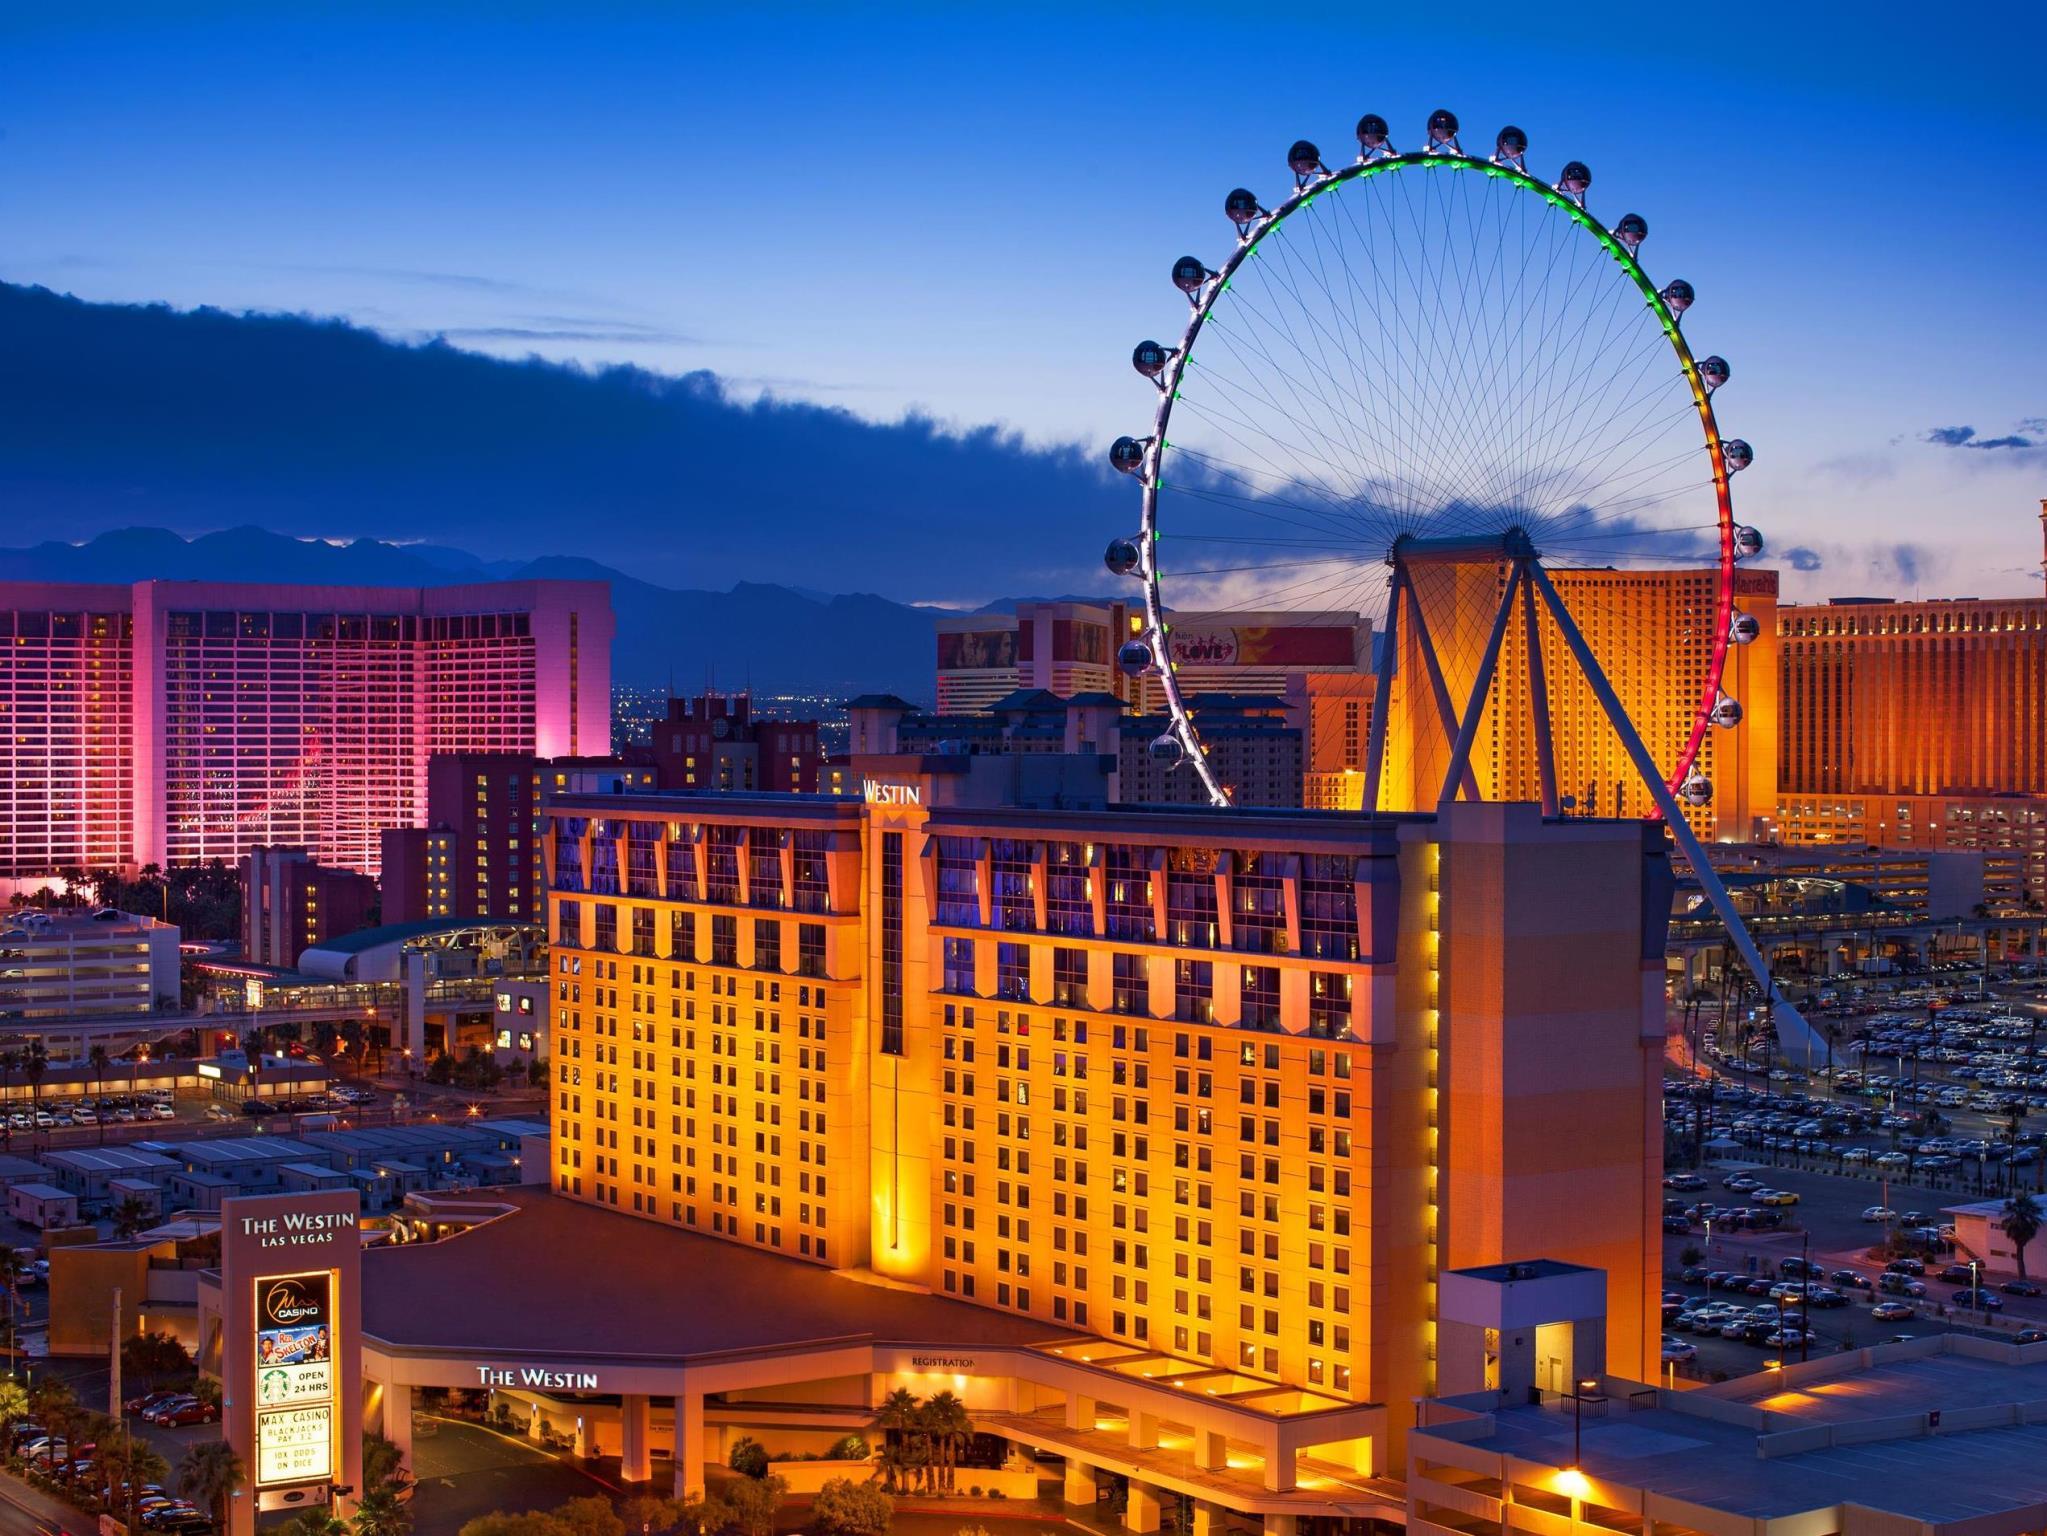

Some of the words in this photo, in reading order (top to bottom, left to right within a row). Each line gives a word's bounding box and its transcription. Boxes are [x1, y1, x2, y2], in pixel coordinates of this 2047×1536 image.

[261, 1238, 286, 1247] LAS
[291, 1232, 333, 1244] VEGAS
[278, 1307, 318, 1318] CASINO
[274, 1335, 317, 1359] SKELTON
[912, 1357, 976, 1367] REGISTRATION
[298, 1371, 324, 1381] OPEN
[294, 1385, 306, 1393] 24
[309, 1383, 328, 1391] HRS
[261, 1415, 285, 1426] MAX
[293, 1410, 329, 1423] CASINO
